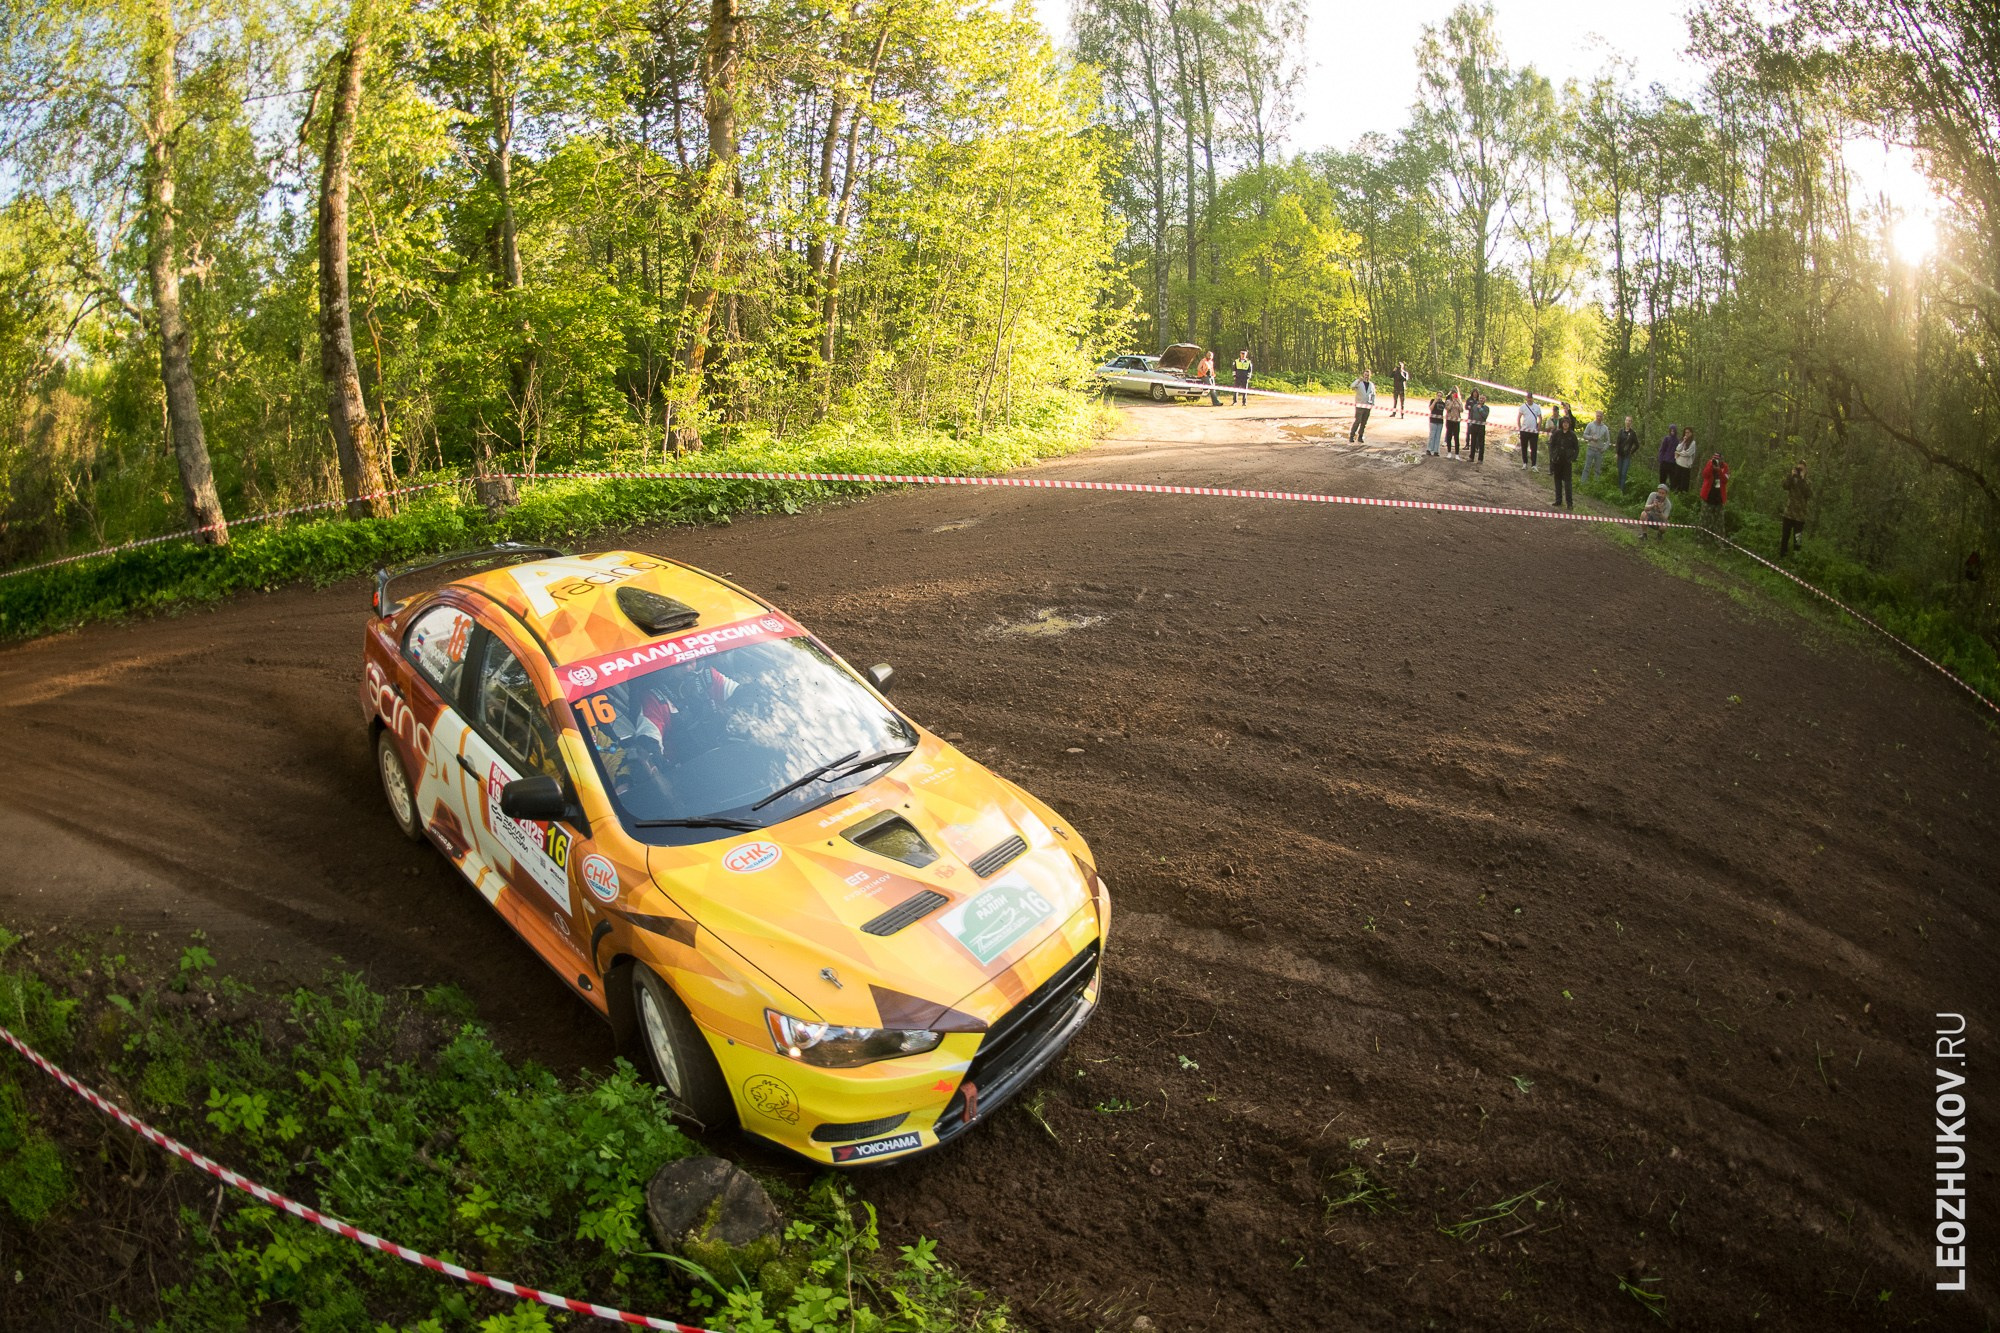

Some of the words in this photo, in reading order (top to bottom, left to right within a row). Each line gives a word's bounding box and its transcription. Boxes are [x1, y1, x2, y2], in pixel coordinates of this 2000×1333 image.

[550, 561, 668, 601] racing
[448, 614, 472, 663] 16
[599, 641, 683, 676] РАЛЛИ
[682, 622, 765, 650] РОССИИ
[365, 662, 439, 780] racing
[574, 694, 618, 727] 16
[547, 826, 567, 867] 16
[729, 842, 770, 871] CHK
[753, 852, 774, 867] GARAGE
[584, 862, 615, 890] CHK
[844, 871, 871, 888] EG
[976, 894, 1009, 920] РАЛЛИ
[1018, 890, 1052, 919] 16
[856, 1135, 919, 1155] YOKOHAMA
